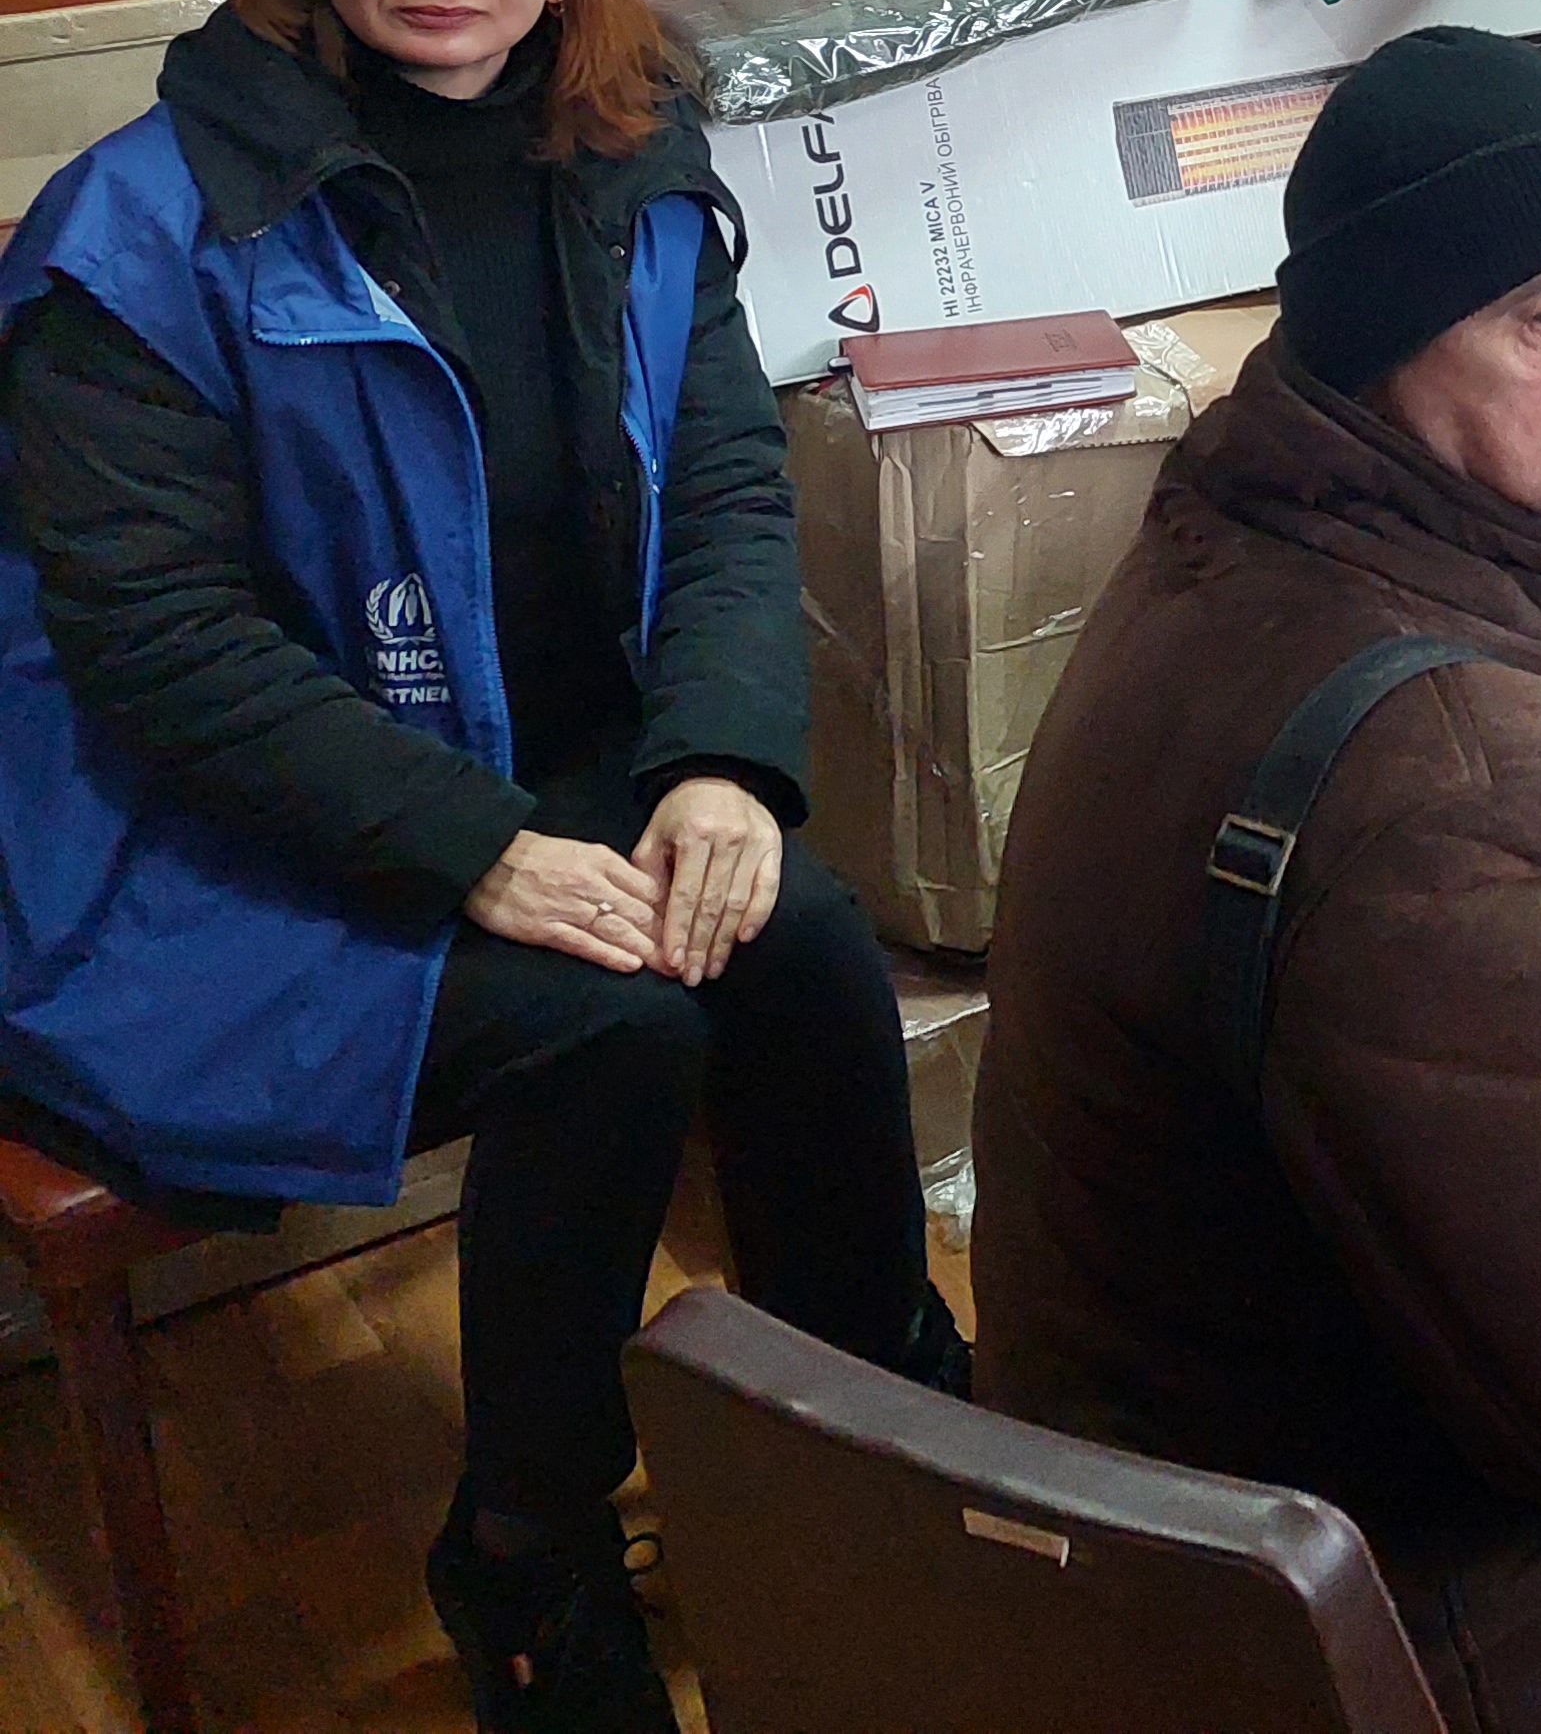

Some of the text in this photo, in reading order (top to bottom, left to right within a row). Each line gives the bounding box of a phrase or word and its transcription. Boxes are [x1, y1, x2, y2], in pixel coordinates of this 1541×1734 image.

[919, 181, 961, 319] HI 22232 MICA V
[937, 162, 984, 314] ІНФРАЧЕРВОНИЙ
